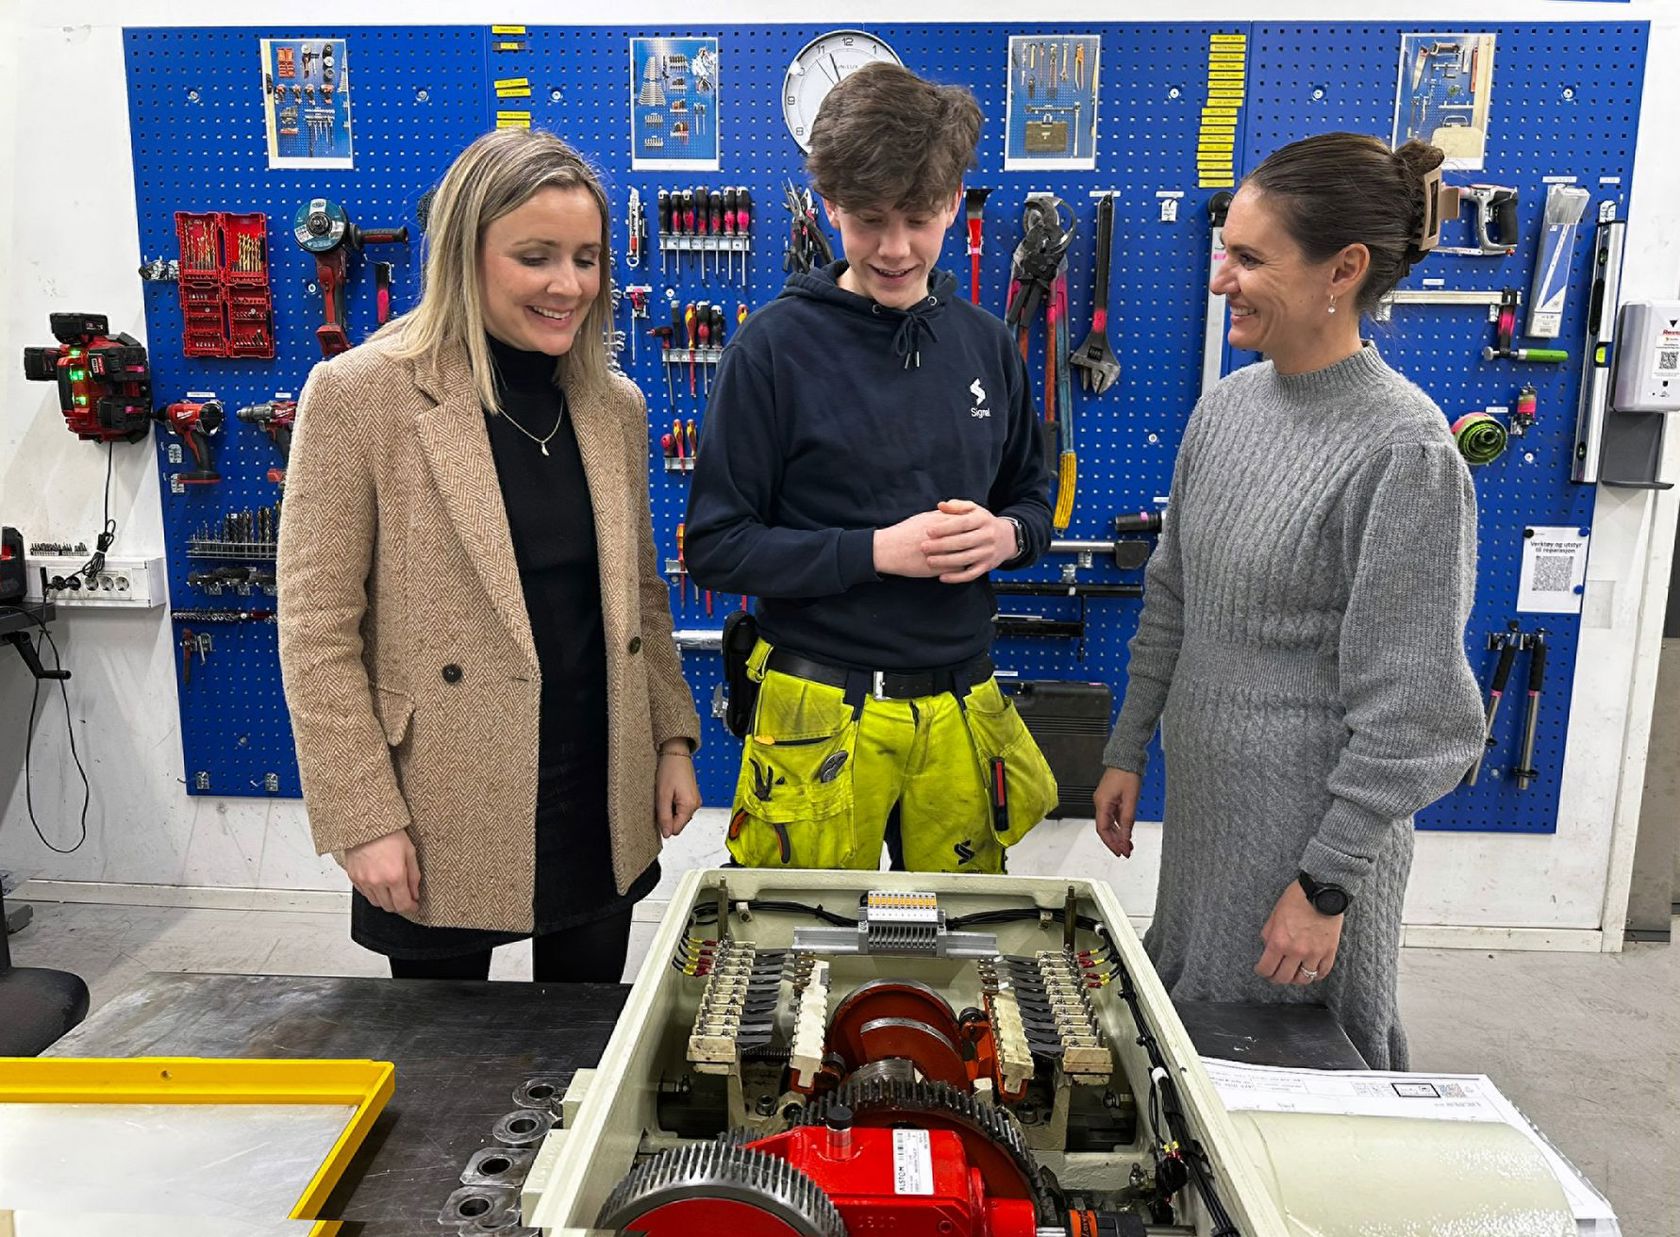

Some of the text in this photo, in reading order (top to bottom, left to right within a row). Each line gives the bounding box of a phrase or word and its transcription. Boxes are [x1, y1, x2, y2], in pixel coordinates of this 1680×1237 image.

[841, 37, 854, 46] 12
[816, 44, 825, 54] 11
[872, 44, 878, 54] 1
[787, 95, 796, 105] 9
[796, 127, 804, 136] 8
[970, 407, 991, 419] Signal
[898, 1166, 906, 1192] ALSTOM
